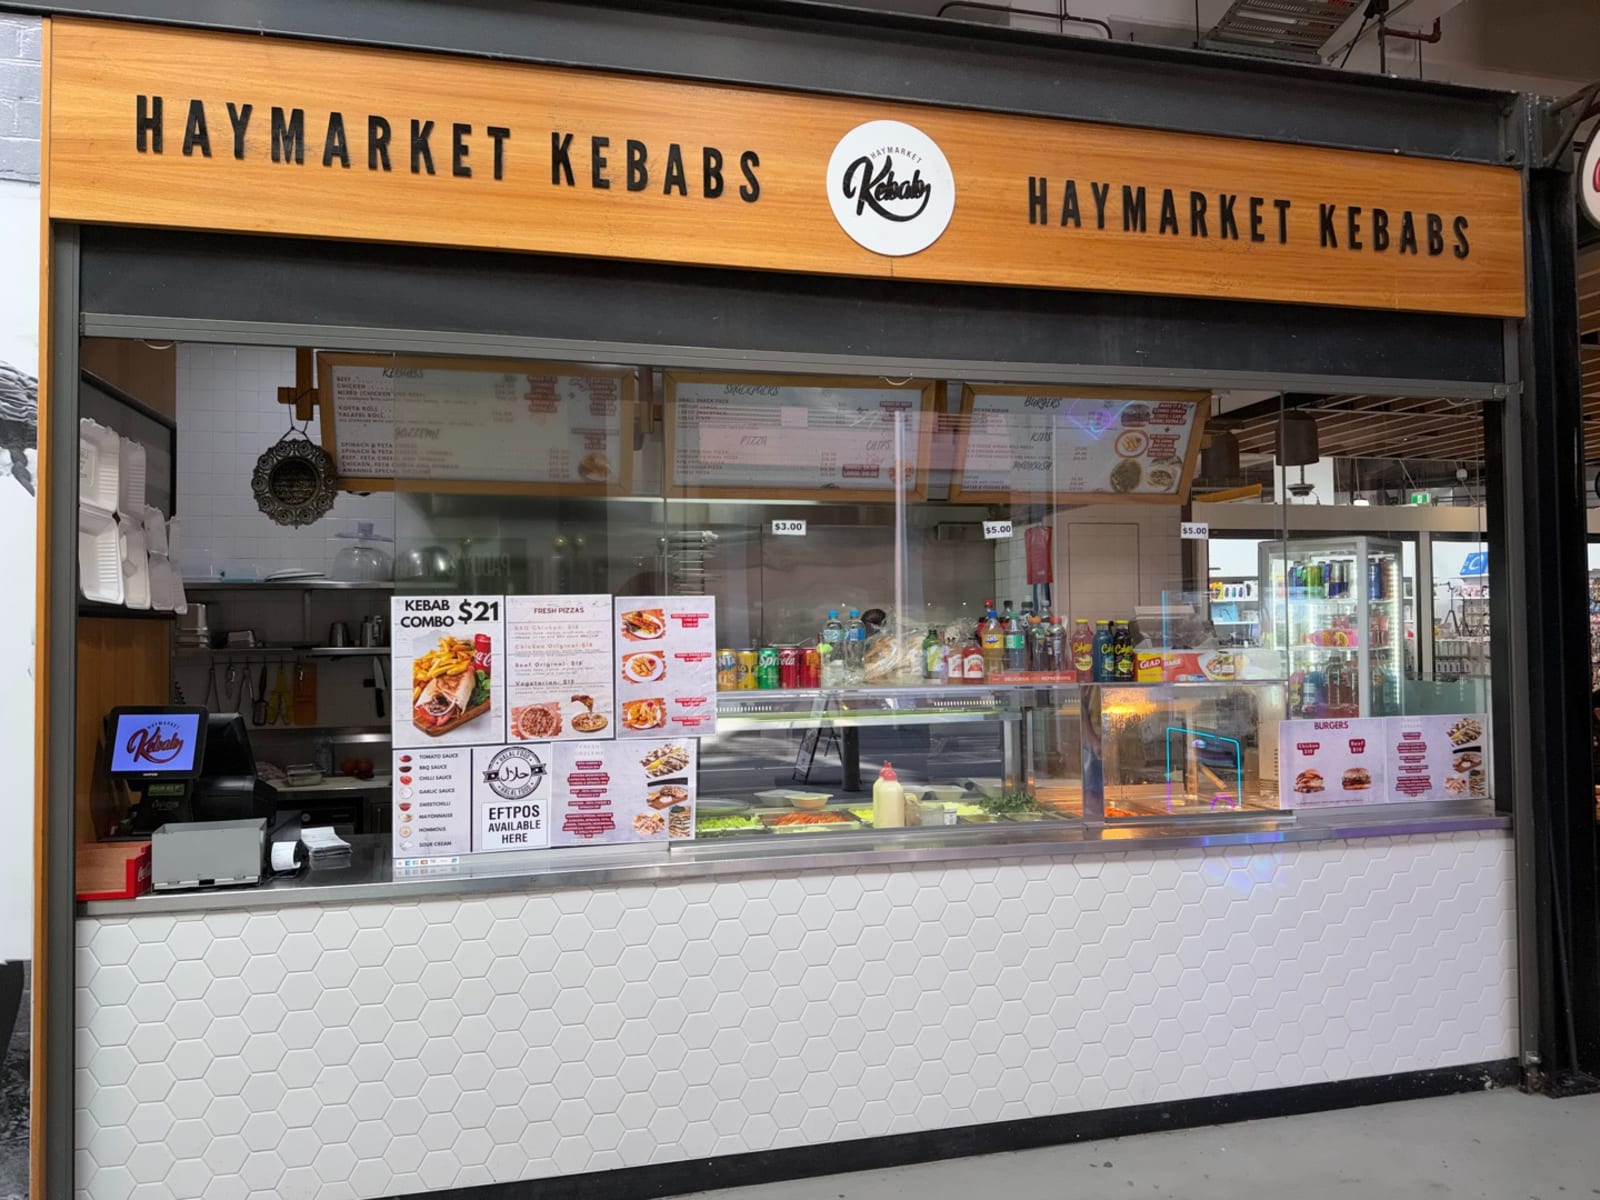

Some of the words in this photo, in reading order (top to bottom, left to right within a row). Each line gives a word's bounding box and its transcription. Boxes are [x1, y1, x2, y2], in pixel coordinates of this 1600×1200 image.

[136, 94, 510, 180] HAYMARKET
[551, 132, 760, 203] KEBABS
[870, 146, 922, 164] HAYMARKET
[1028, 176, 1291, 244] HAYMARKET
[1319, 203, 1470, 259] KEBABS
[775, 522, 802, 531] $3.00
[986, 525, 1011, 534] $5.00
[1183, 527, 1207, 535] $5.00
[405, 599, 450, 611] KEBAB
[458, 598, 499, 625] $21
[400, 616, 455, 628] COMBO
[1139, 658, 1161, 669] GLAD
[1314, 721, 1349, 730] BURGERS
[501, 766, 529, 782] حلال
[489, 804, 540, 820] EFTPOS
[488, 819, 541, 833] AVAILABLE
[501, 832, 528, 844] HERE
